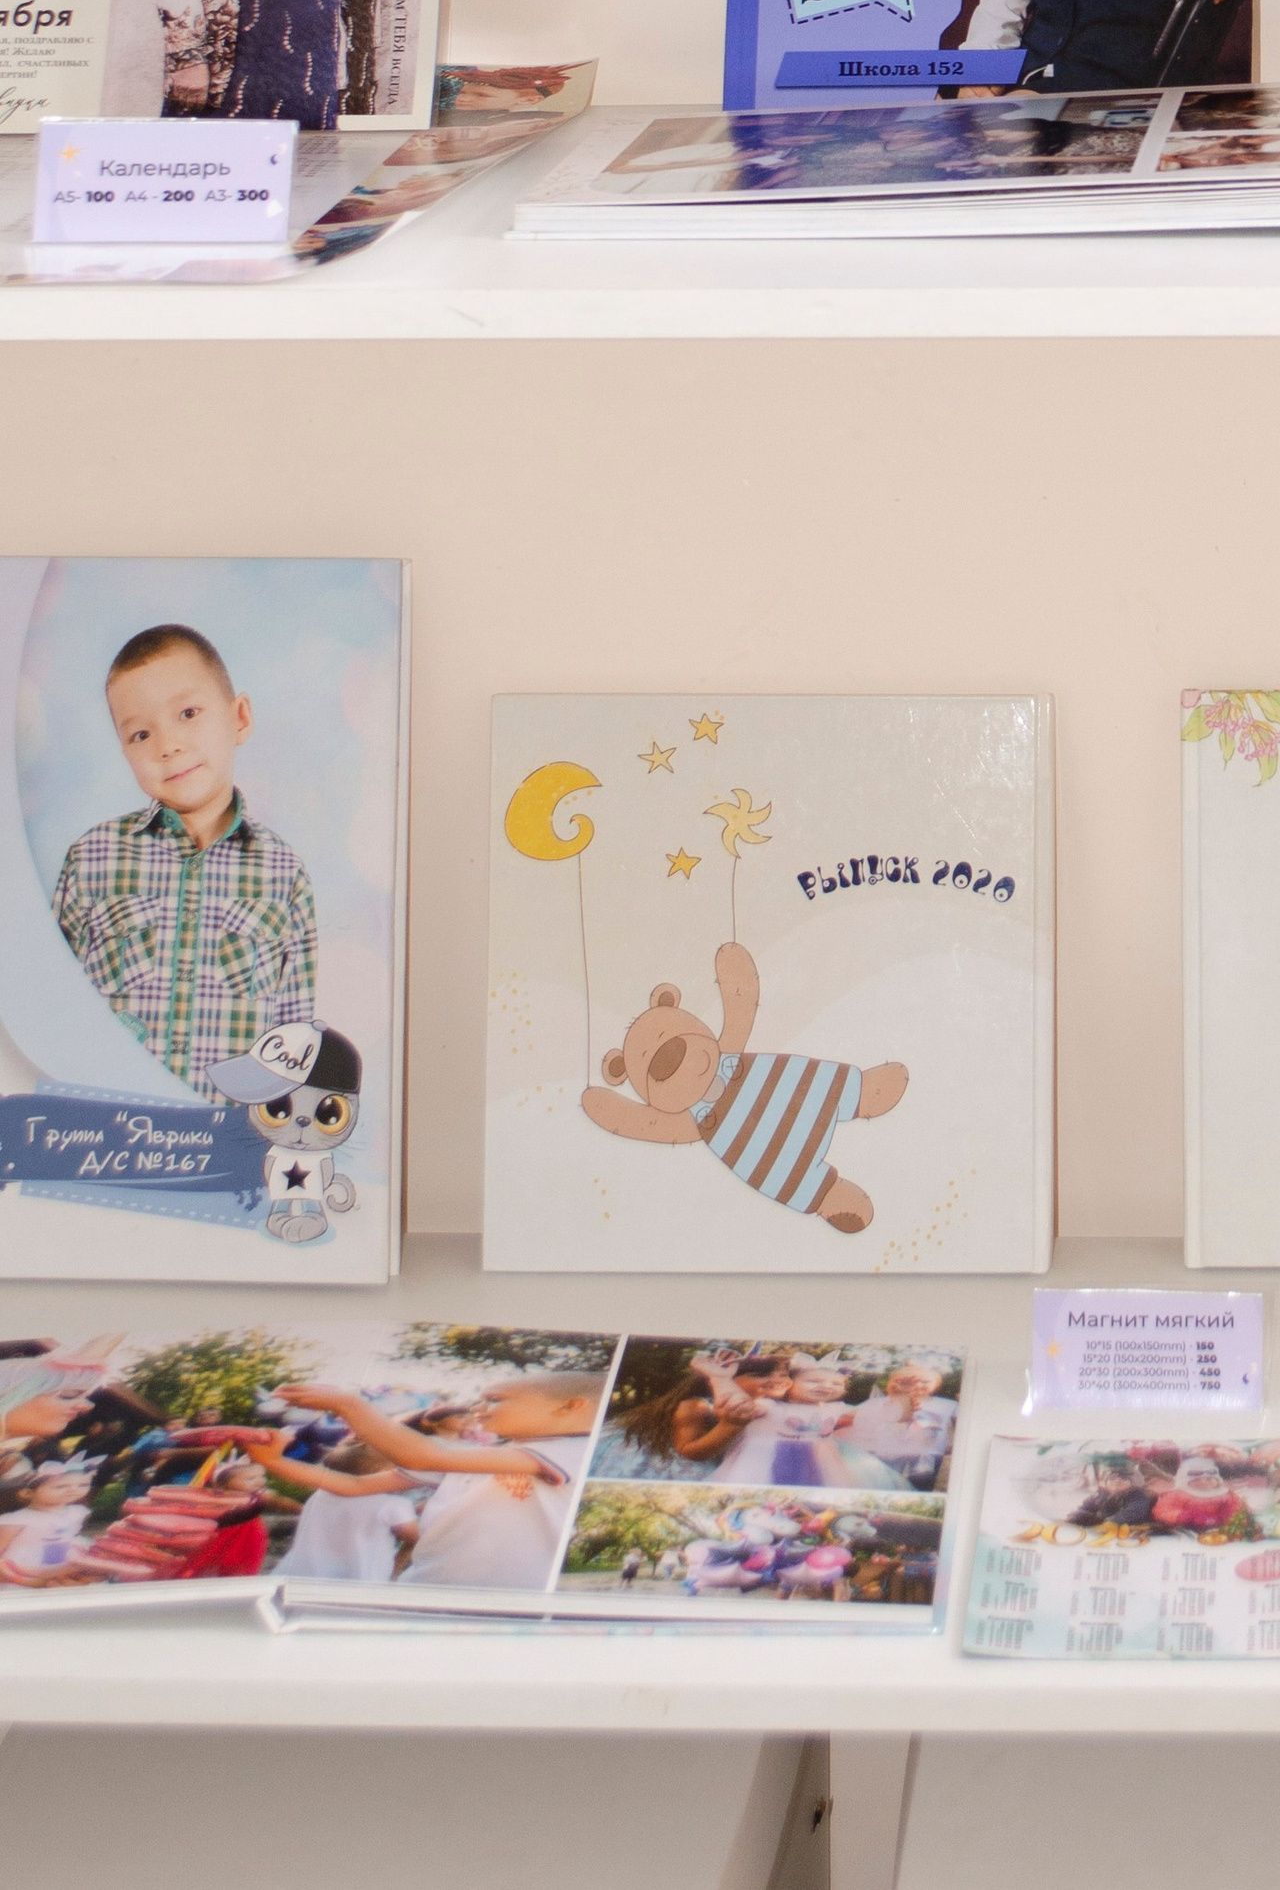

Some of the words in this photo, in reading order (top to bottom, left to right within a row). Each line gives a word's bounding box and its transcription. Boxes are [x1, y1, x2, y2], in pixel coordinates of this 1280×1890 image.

[837, 61, 922, 77] Школа
[927, 61, 965, 77] 152
[100, 160, 232, 179] Календарь
[86, 190, 115, 203] 100
[162, 189, 195, 203] 200
[237, 189, 270, 202] 300
[932, 859, 1016, 903] 2020
[259, 1034, 315, 1072] Cool
[79, 1150, 129, 1175] Д/С
[136, 1151, 212, 1173] №167
[1067, 1311, 1149, 1328] Магнит
[1155, 1311, 1235, 1329] мягкий
[1195, 1341, 1215, 1350] 150
[1196, 1354, 1218, 1363] 250
[1198, 1367, 1221, 1377] 450
[1200, 1380, 1221, 1390] 750
